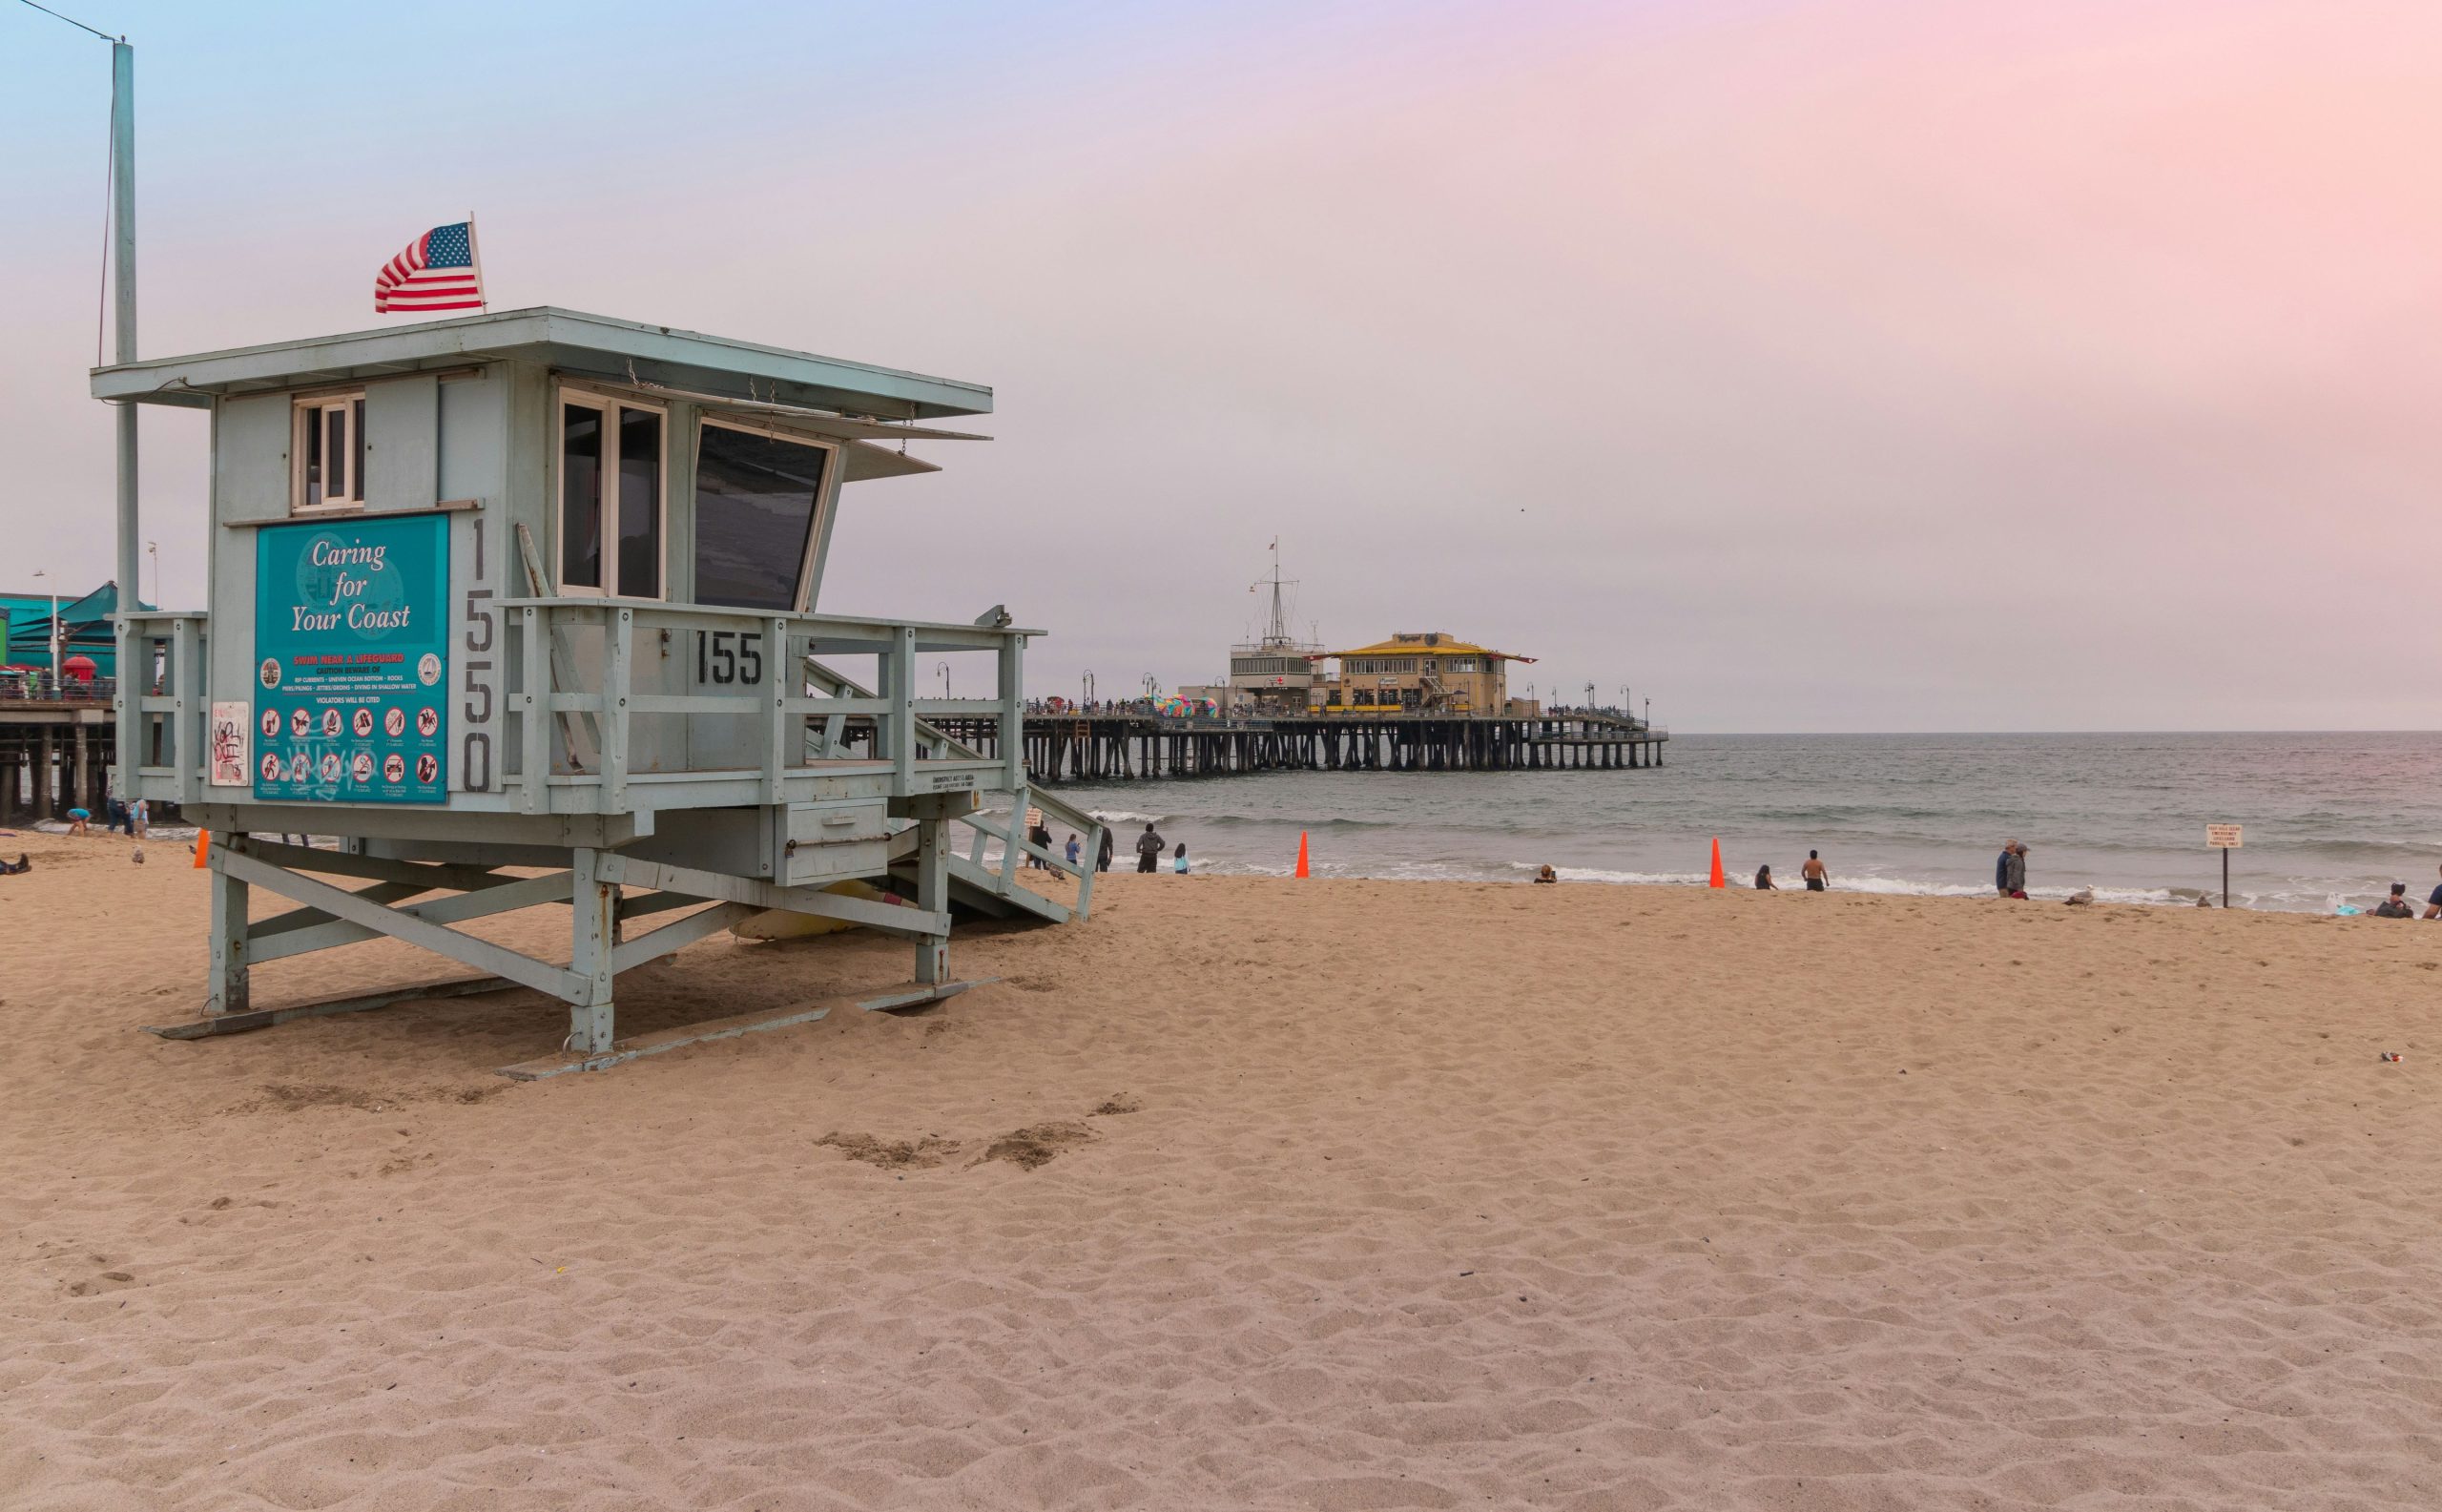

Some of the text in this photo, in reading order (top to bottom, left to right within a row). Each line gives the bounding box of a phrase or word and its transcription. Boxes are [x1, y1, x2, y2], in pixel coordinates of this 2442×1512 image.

[312, 538, 386, 571] Caring
[329, 571, 367, 606] for
[291, 603, 411, 632] Your Coast
[294, 653, 404, 666] SWIM NEAR A LIFEGUARD
[464, 519, 493, 793] 1550
[697, 631, 788, 685] 155
